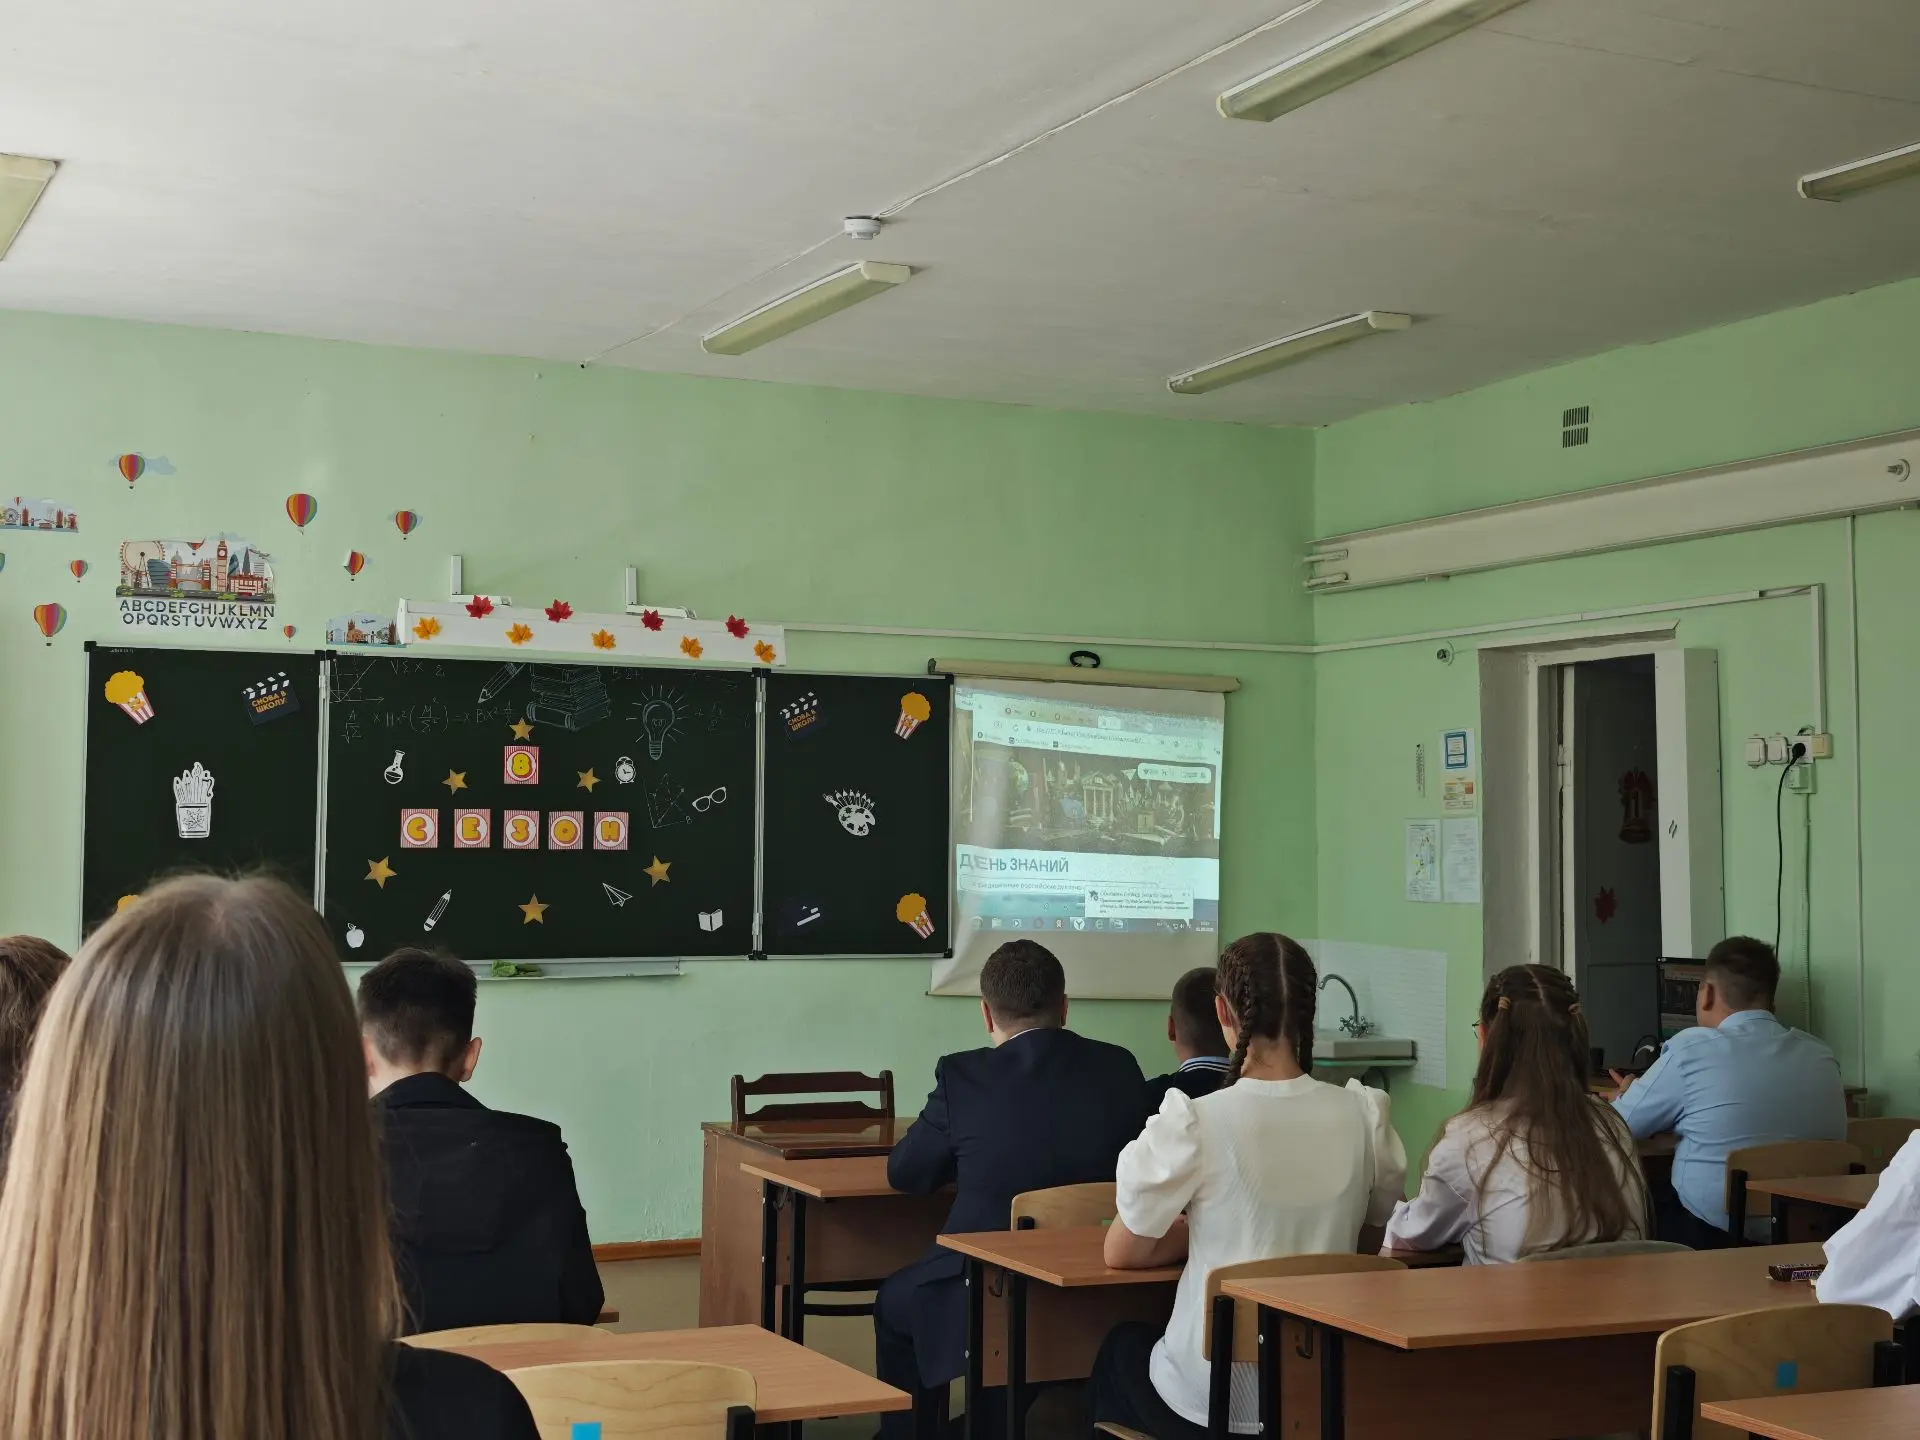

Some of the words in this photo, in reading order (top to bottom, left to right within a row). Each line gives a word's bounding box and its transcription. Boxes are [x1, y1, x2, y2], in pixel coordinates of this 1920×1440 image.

[119, 600, 275, 618] ABCDEFGHIJKLMN
[122, 612, 268, 630] OPQRSTUVWXYZ
[252, 693, 280, 707] СНОВА
[256, 698, 286, 713] ШКОЛУ
[788, 711, 811, 726] СНОВА
[792, 715, 816, 731] ШКОЛУ
[511, 752, 533, 778] 8
[406, 816, 621, 845] СЕЗОН
[960, 854, 1007, 871] ДЕНЬ
[1010, 857, 1069, 872] ЗНАНИЙ
